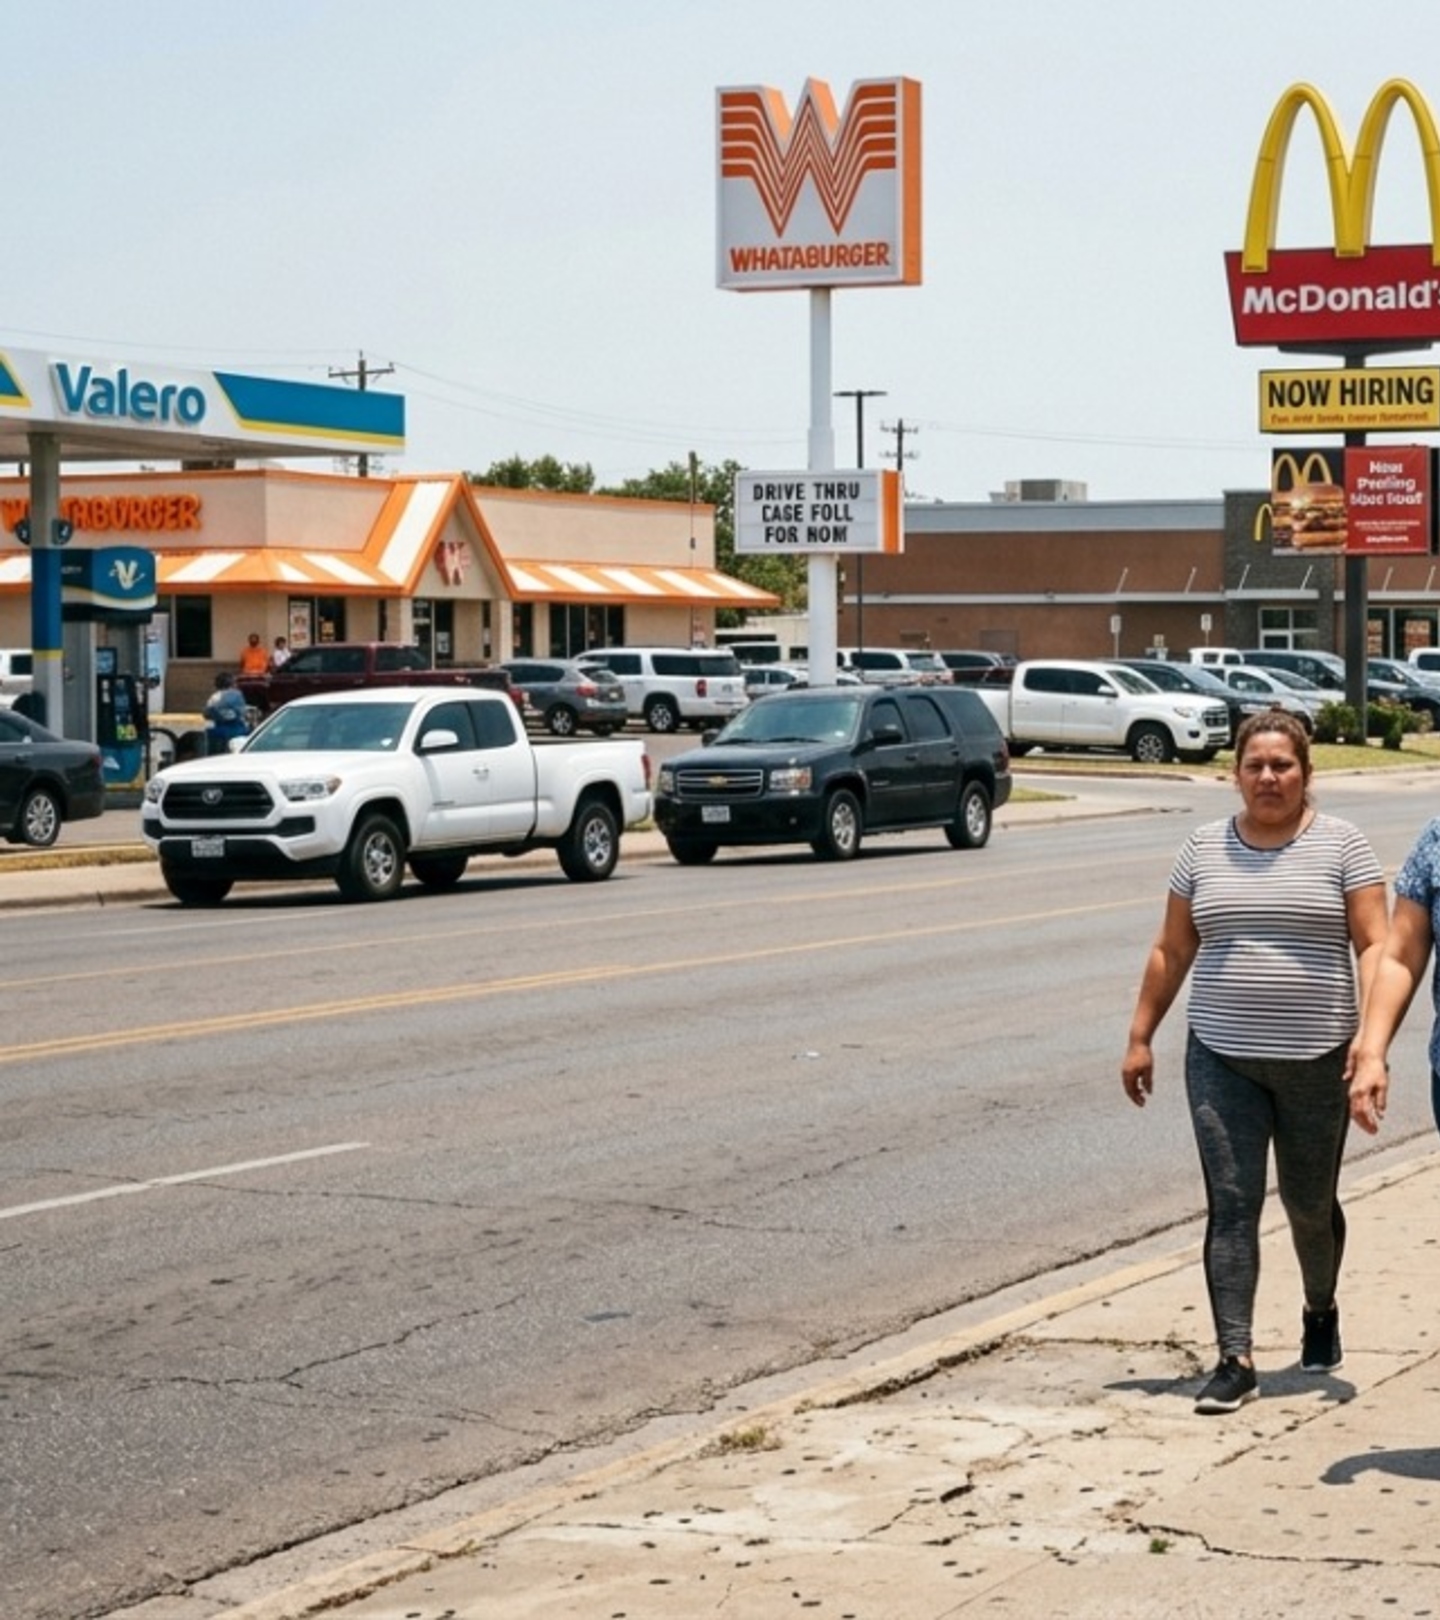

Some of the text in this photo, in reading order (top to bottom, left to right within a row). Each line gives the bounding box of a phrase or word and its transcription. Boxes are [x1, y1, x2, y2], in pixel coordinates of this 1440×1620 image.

[730, 242, 890, 273] WHATABURGER
[55, 362, 206, 424] Valero
[1267, 375, 1435, 408] NOW HIRING
[753, 482, 860, 501] DRIVE THRU
[762, 504, 804, 522] CASE
